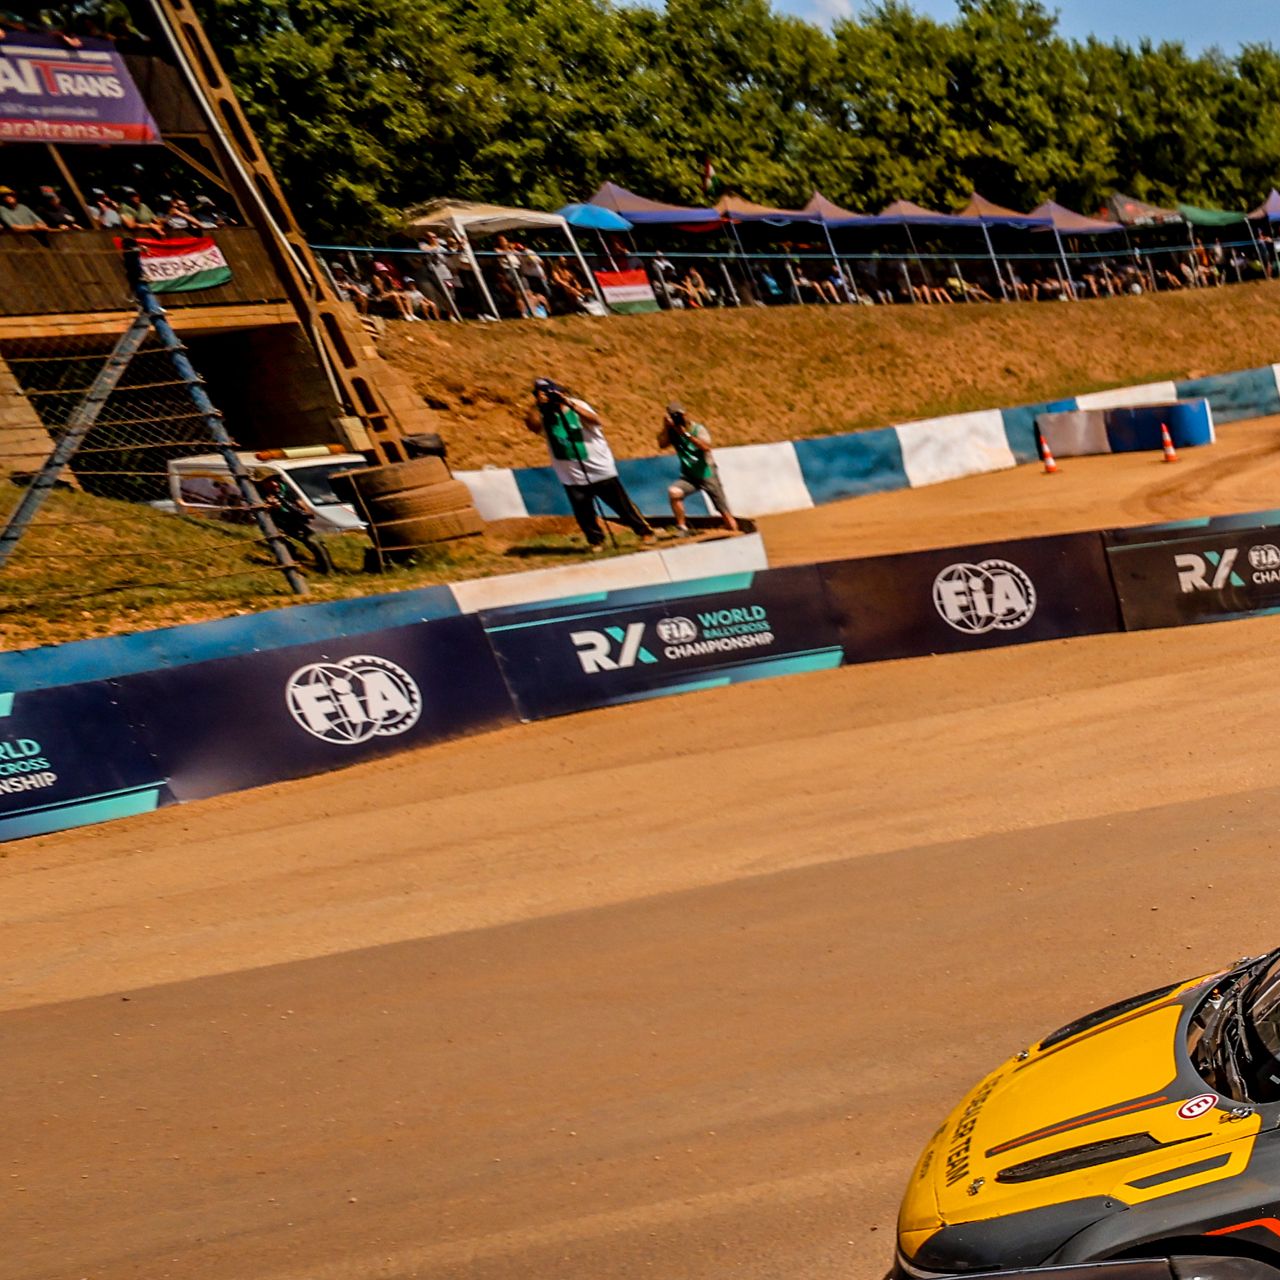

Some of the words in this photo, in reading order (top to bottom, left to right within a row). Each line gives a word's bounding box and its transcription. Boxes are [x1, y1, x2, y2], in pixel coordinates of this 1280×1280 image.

[1174, 548, 1246, 593] RX
[698, 605, 767, 627] WORLD
[702, 620, 771, 638] RALLYCROSS
[569, 622, 658, 674] RX
[664, 632, 775, 660] CHAMPIONSHIP
[946, 1136, 971, 1187] TEAM
